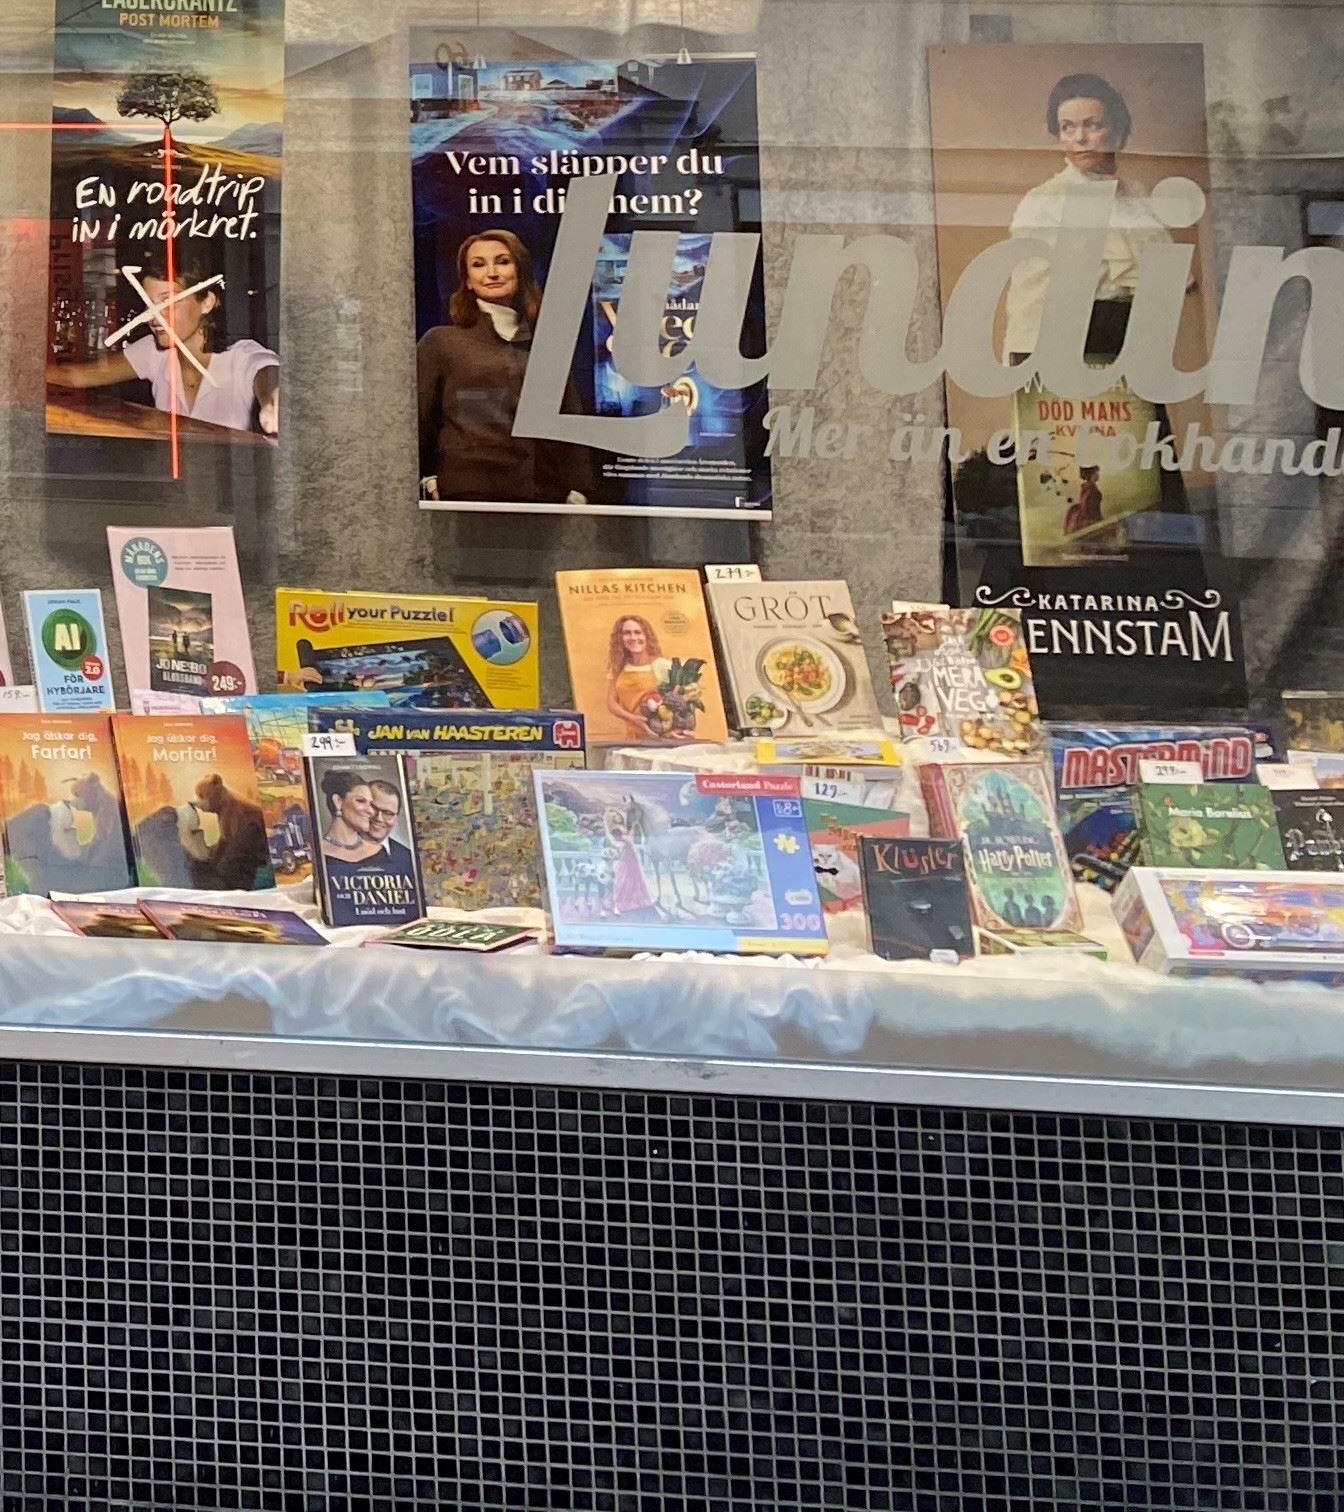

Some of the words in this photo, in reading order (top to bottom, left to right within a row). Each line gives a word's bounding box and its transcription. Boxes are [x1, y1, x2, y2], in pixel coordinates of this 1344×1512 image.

[119, 12, 156, 28] POST
[158, 13, 219, 29] MORTEM
[444, 150, 521, 176] Vem
[676, 148, 724, 176] du
[126, 162, 266, 211] roadtrip
[469, 189, 502, 215] in
[513, 189, 523, 215] i
[108, 212, 121, 242] i
[1037, 397, 1074, 423] DÖD
[1080, 400, 1132, 424] MANS
[762, 407, 860, 460] Mer
[890, 415, 969, 467] än
[987, 431, 1057, 467] en
[1075, 420, 1344, 478] bokhand
[568, 583, 620, 595] NILLAS
[624, 582, 687, 595] KITCHEN
[733, 590, 832, 622] GRÖT
[1037, 594, 1160, 613] KATARINA
[288, 599, 348, 632] Roll
[347, 605, 388, 622] your
[53, 621, 80, 652] AI
[1026, 610, 1235, 663] ENNSTAM
[64, 673, 84, 684] FÖR
[932, 663, 988, 688] MERA
[47, 683, 105, 696] NYBÖRJARE
[21, 730, 42, 744] Jag
[42, 729, 75, 742] älskar
[146, 733, 164, 746] Jag
[166, 732, 196, 745] älskar
[368, 724, 404, 740] JAN
[432, 724, 543, 742] HAASTEREN
[30, 743, 92, 761] Farfar!
[153, 746, 217, 763] Morfar!
[977, 844, 1014, 874] Harry
[1013, 845, 1053, 870] Potter
[329, 874, 414, 890] VICTORIA
[352, 889, 416, 905] DANIEL
[779, 912, 821, 931] 300
